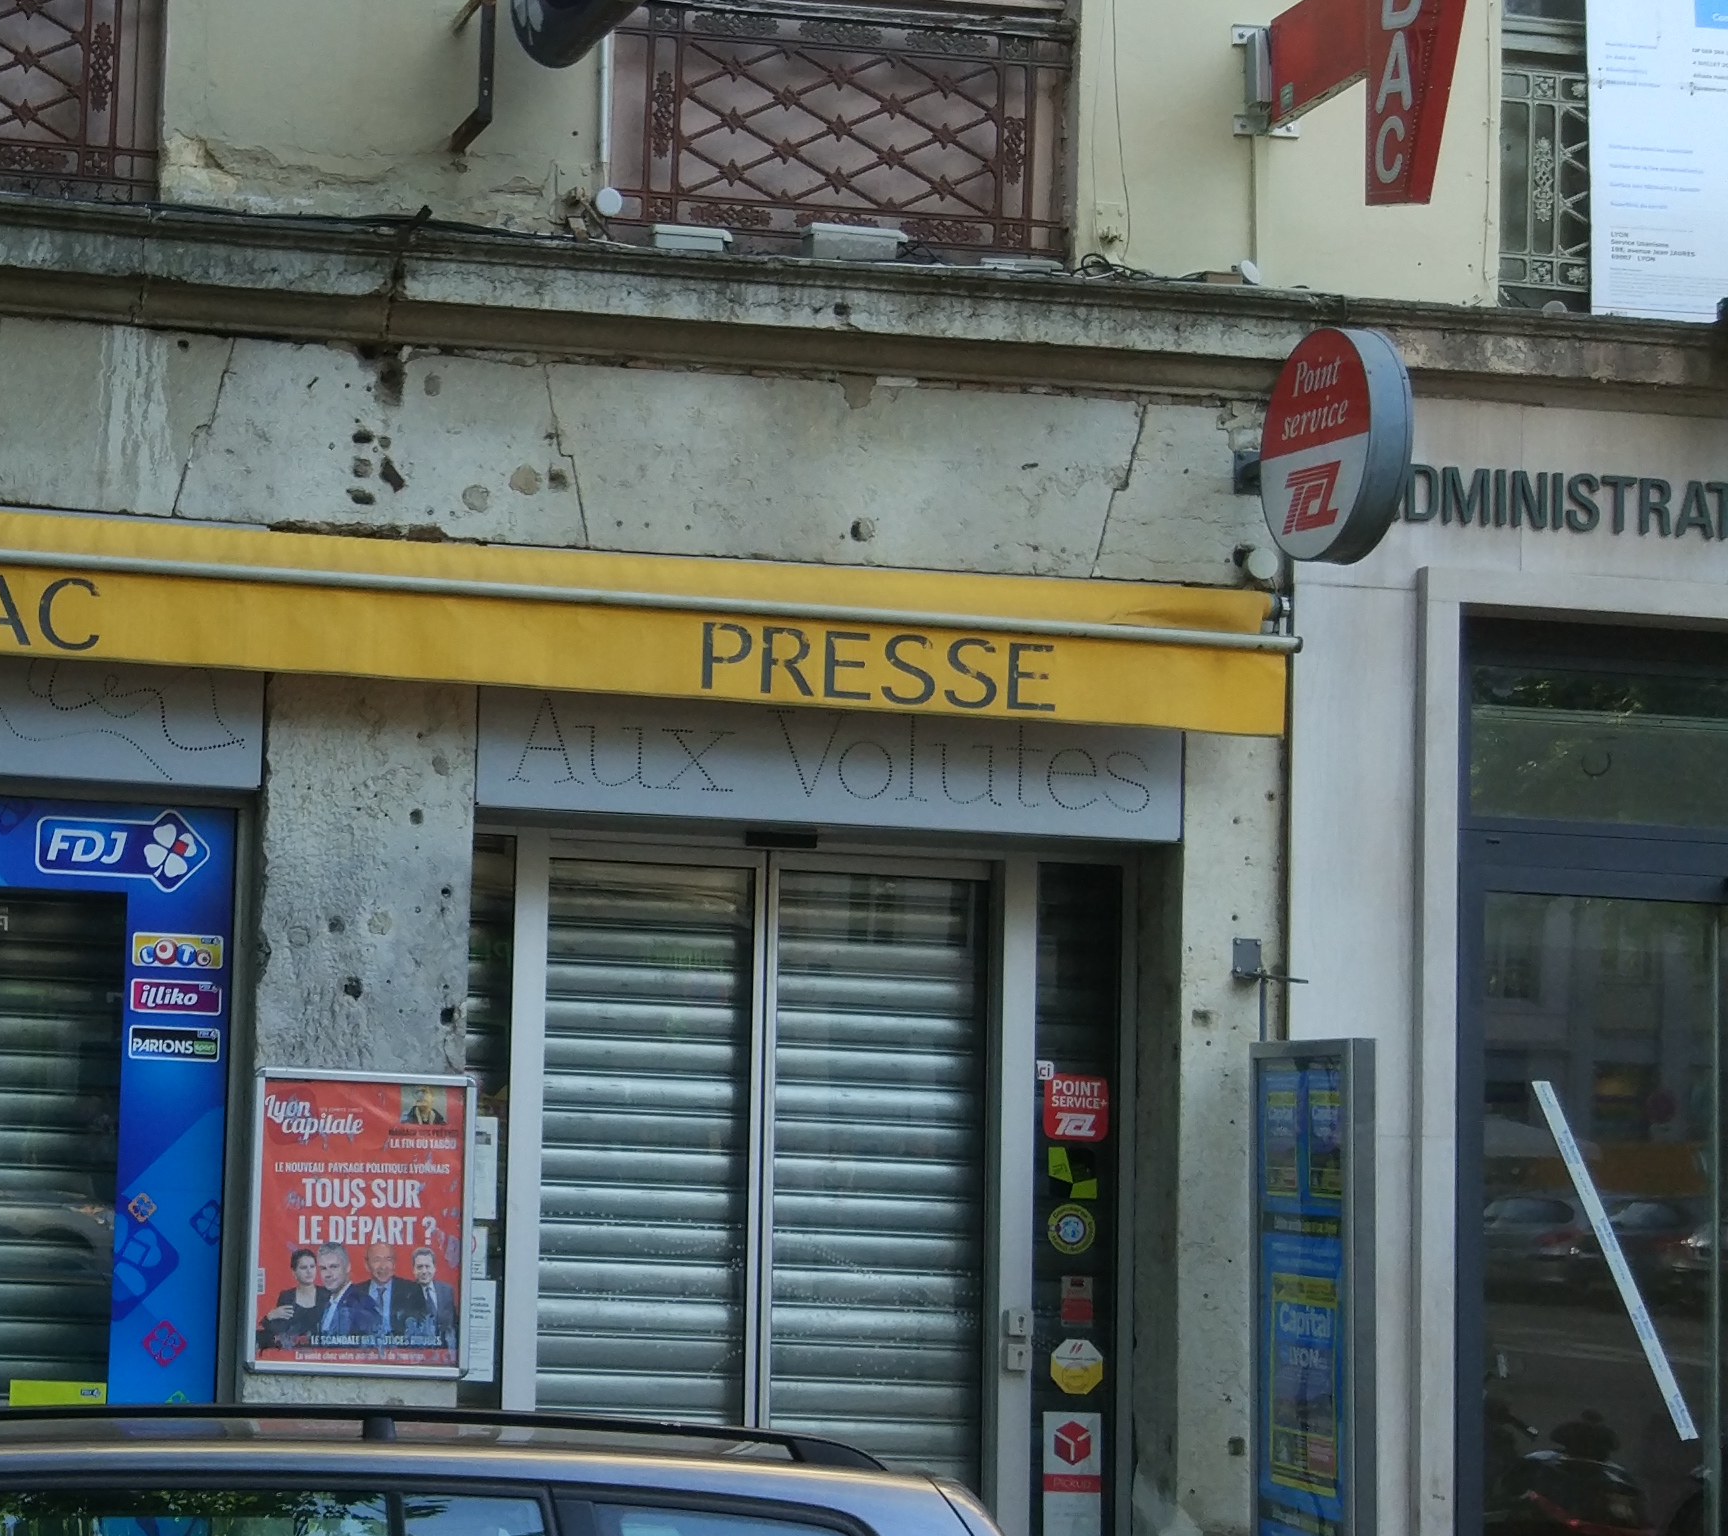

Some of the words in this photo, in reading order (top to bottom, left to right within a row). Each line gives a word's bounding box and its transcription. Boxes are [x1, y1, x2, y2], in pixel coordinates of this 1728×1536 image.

[1291, 354, 1342, 398] Point
[1281, 395, 1349, 441] service
[1281, 460, 1342, 535] TCL
[1393, 463, 1728, 542] DMINISTRAT
[700, 621, 1056, 712] PRESSE
[506, 694, 736, 792] Aux
[768, 709, 1151, 813] Volutes
[46, 828, 128, 865] FDJ
[140, 938, 212, 966] LOTO
[140, 984, 198, 1007] illiko
[132, 1038, 194, 1054] PARIONS
[1051, 1079, 1102, 1098] POINT
[264, 1094, 311, 1124] Lyon
[1054, 1111, 1097, 1137] TCL
[282, 1113, 365, 1140] capitale
[390, 1138, 400, 1148] LA
[401, 1138, 414, 1149] FIN
[416, 1139, 427, 1149] DU
[275, 1161, 284, 1172] LE
[285, 1162, 324, 1173] NOUVEAU
[328, 1162, 365, 1173] PAYSAGE
[366, 1162, 408, 1174] POLITIQUE
[409, 1163, 450, 1174] LYONNAIS
[302, 1177, 366, 1209] TOUS
[372, 1179, 422, 1209] SUR
[299, 1215, 323, 1245] LE
[329, 1207, 418, 1245] DÉPART
[422, 1217, 437, 1246] ?
[1279, 1302, 1332, 1340] Capital
[1288, 1345, 1319, 1368] LYON
